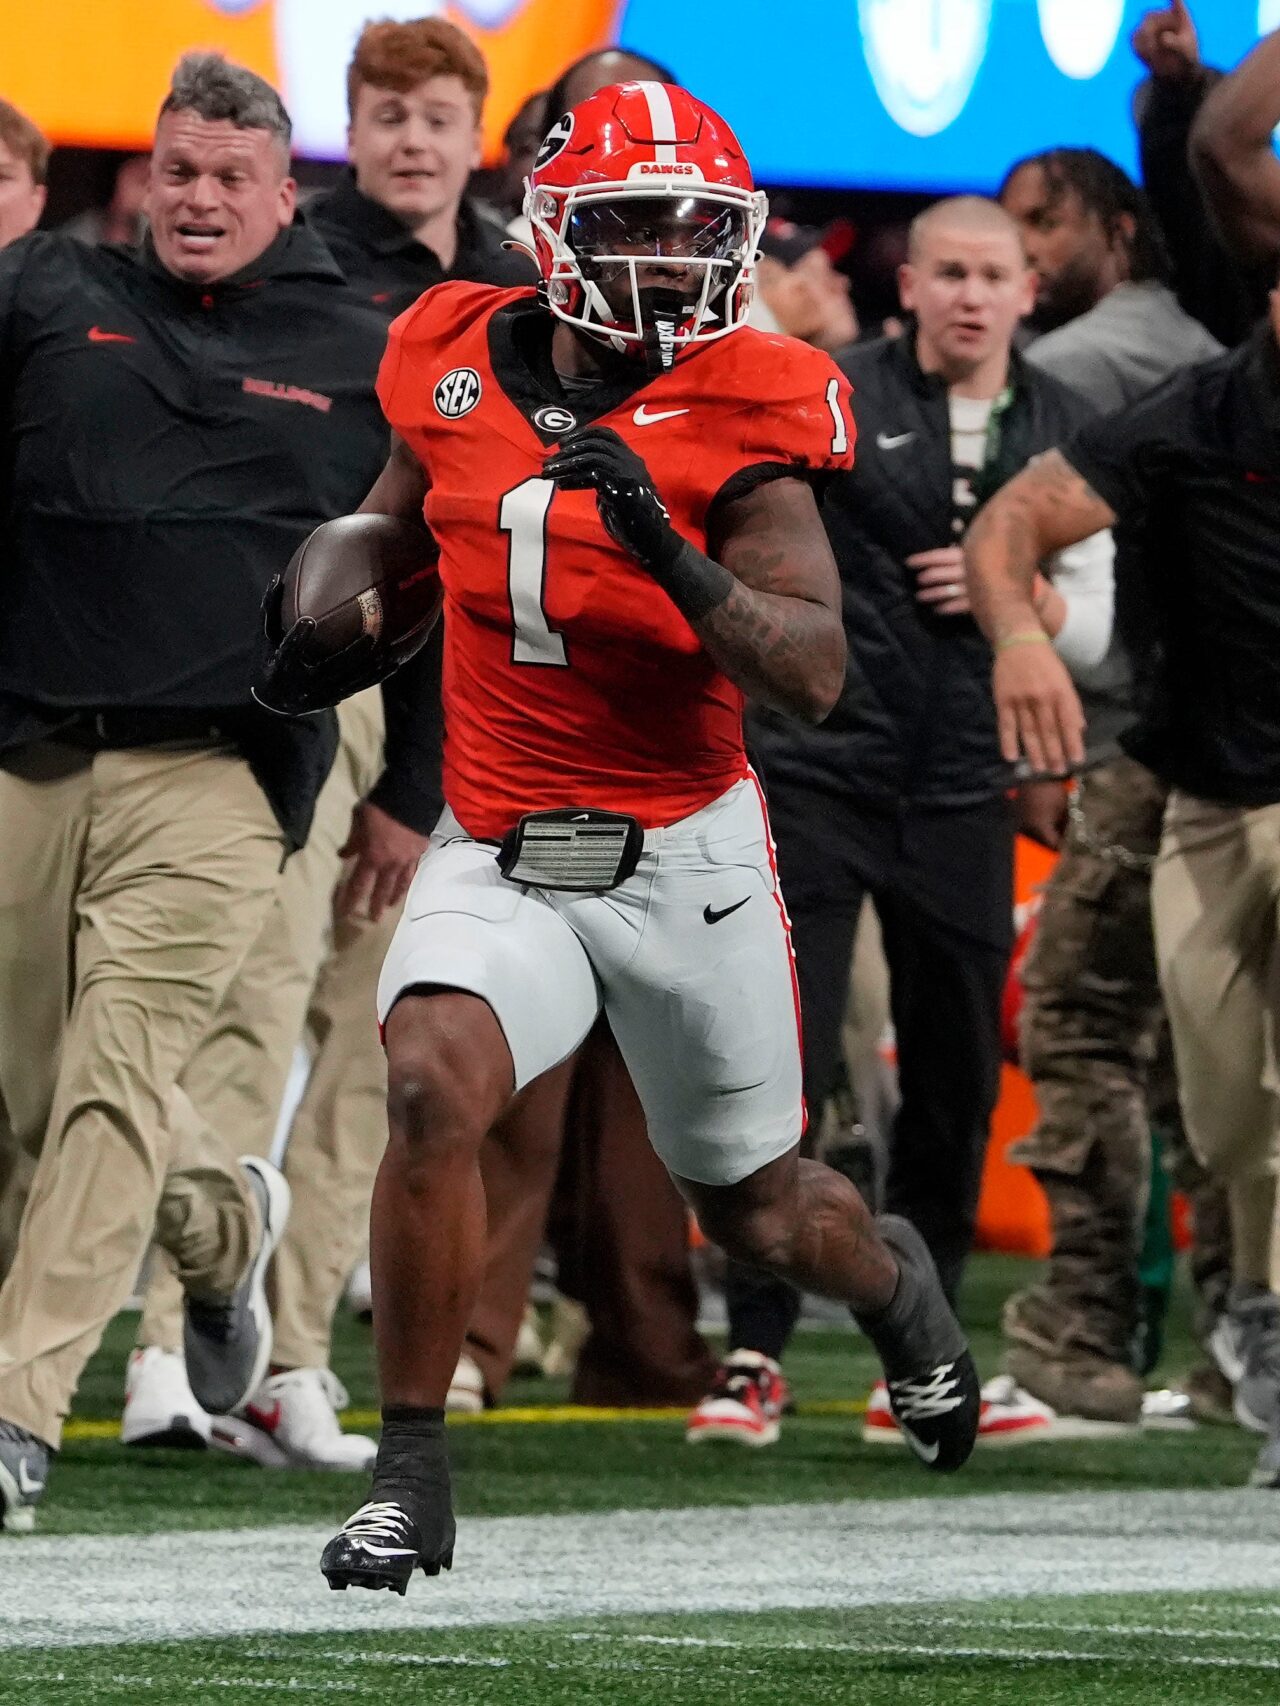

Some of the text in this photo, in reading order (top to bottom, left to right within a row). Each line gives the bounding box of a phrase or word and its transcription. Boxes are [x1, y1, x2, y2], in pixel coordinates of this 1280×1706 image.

[640, 164, 693, 175] DAWGS
[655, 320, 675, 367] NXRND
[437, 370, 479, 416] SEC
[533, 407, 576, 433] G
[824, 378, 848, 455] 1
[498, 475, 569, 665] 1
